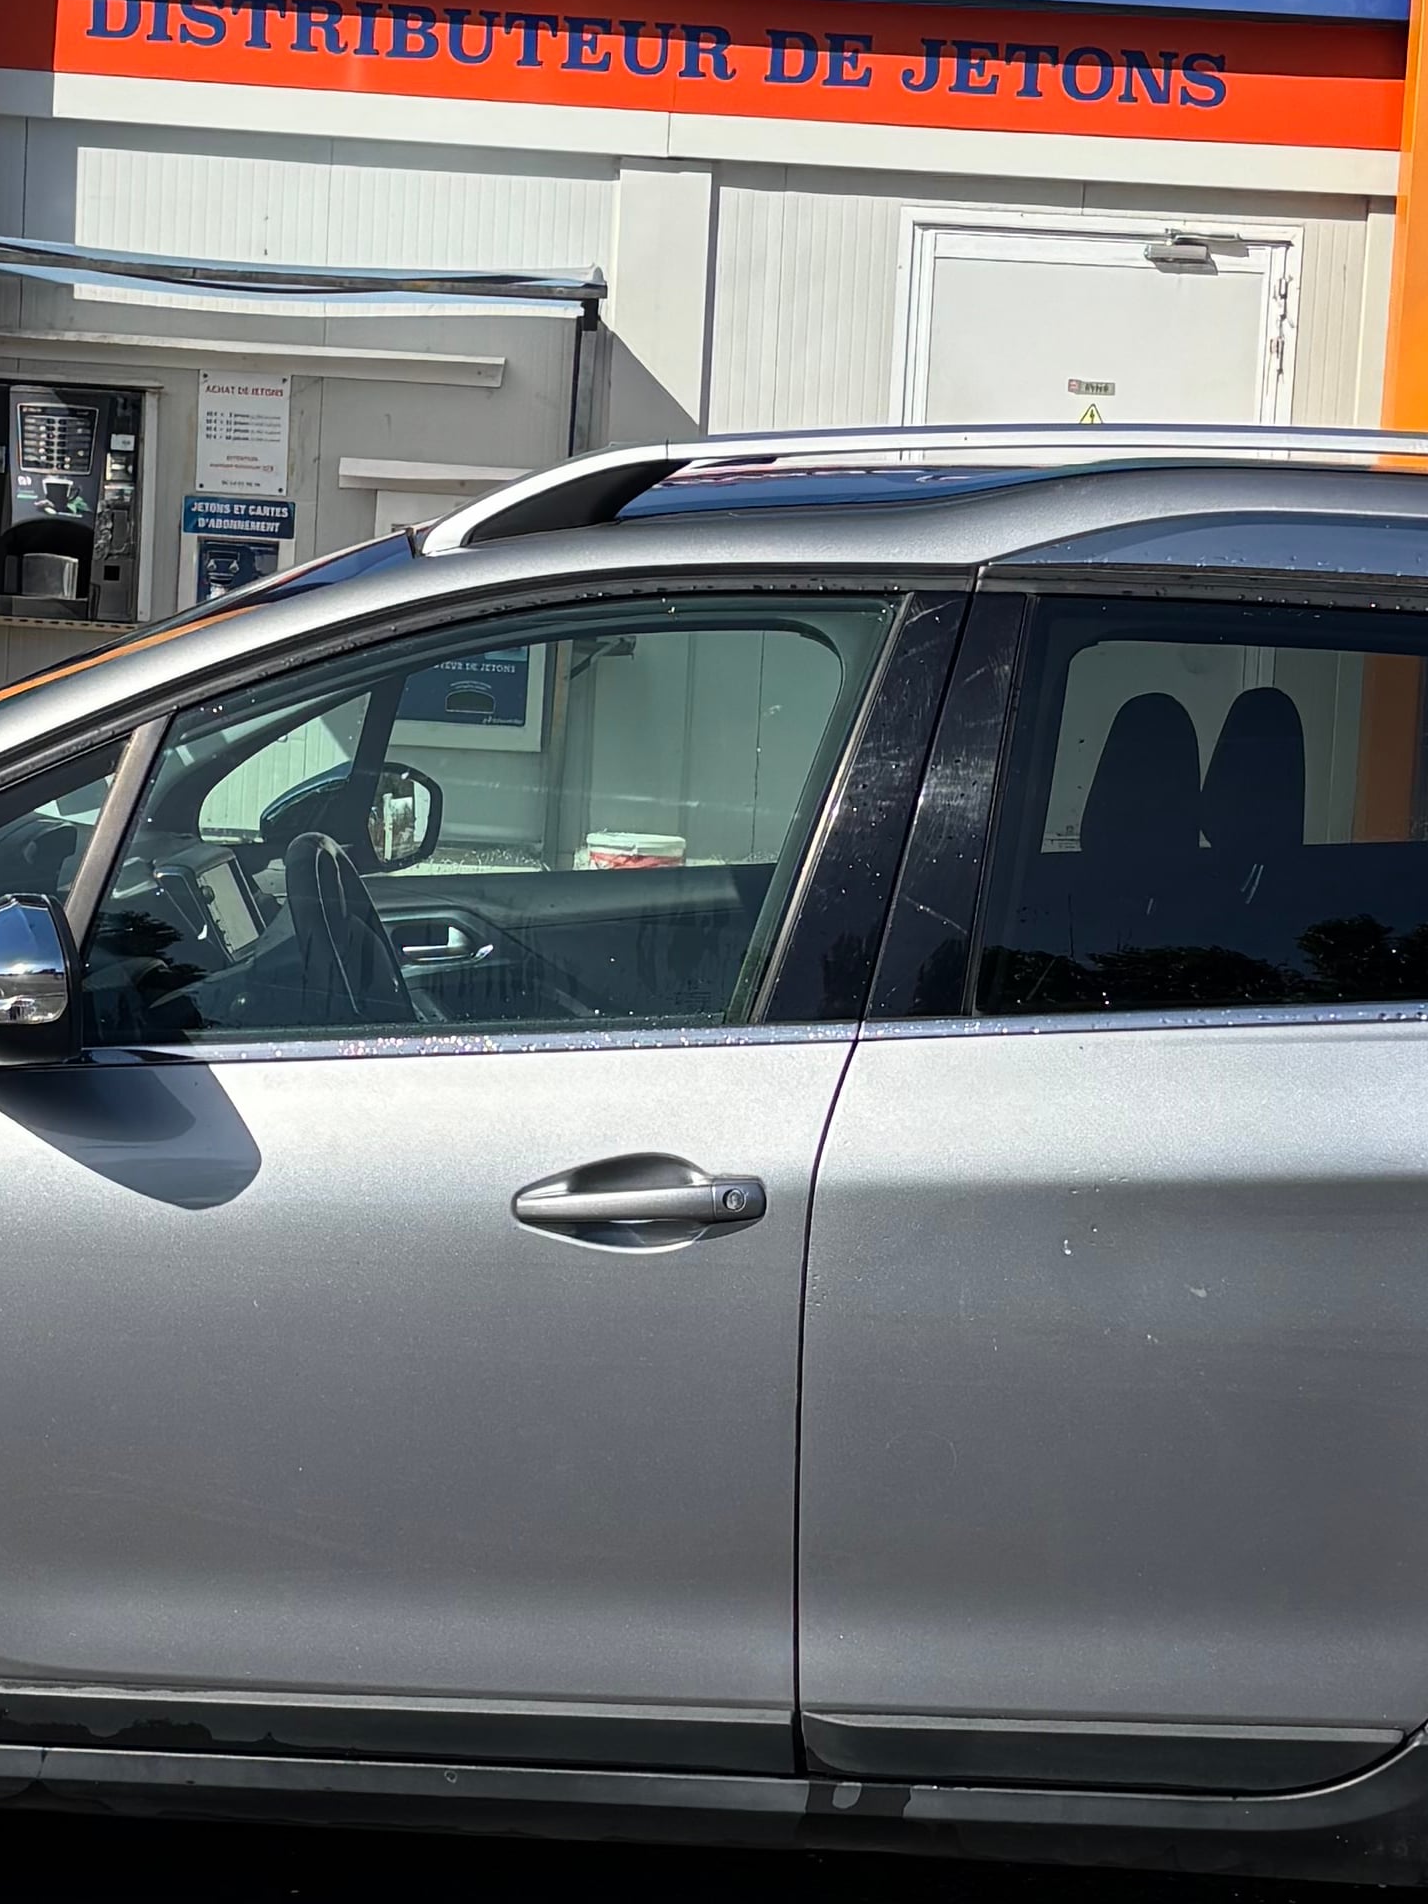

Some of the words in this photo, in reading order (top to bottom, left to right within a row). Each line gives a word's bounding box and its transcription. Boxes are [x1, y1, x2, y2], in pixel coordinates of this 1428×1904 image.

[764, 29, 873, 88] DE
[900, 37, 1228, 109] JETONS
[191, 501, 230, 514] JETONS
[233, 503, 247, 515] ET
[249, 505, 289, 518] CARTES
